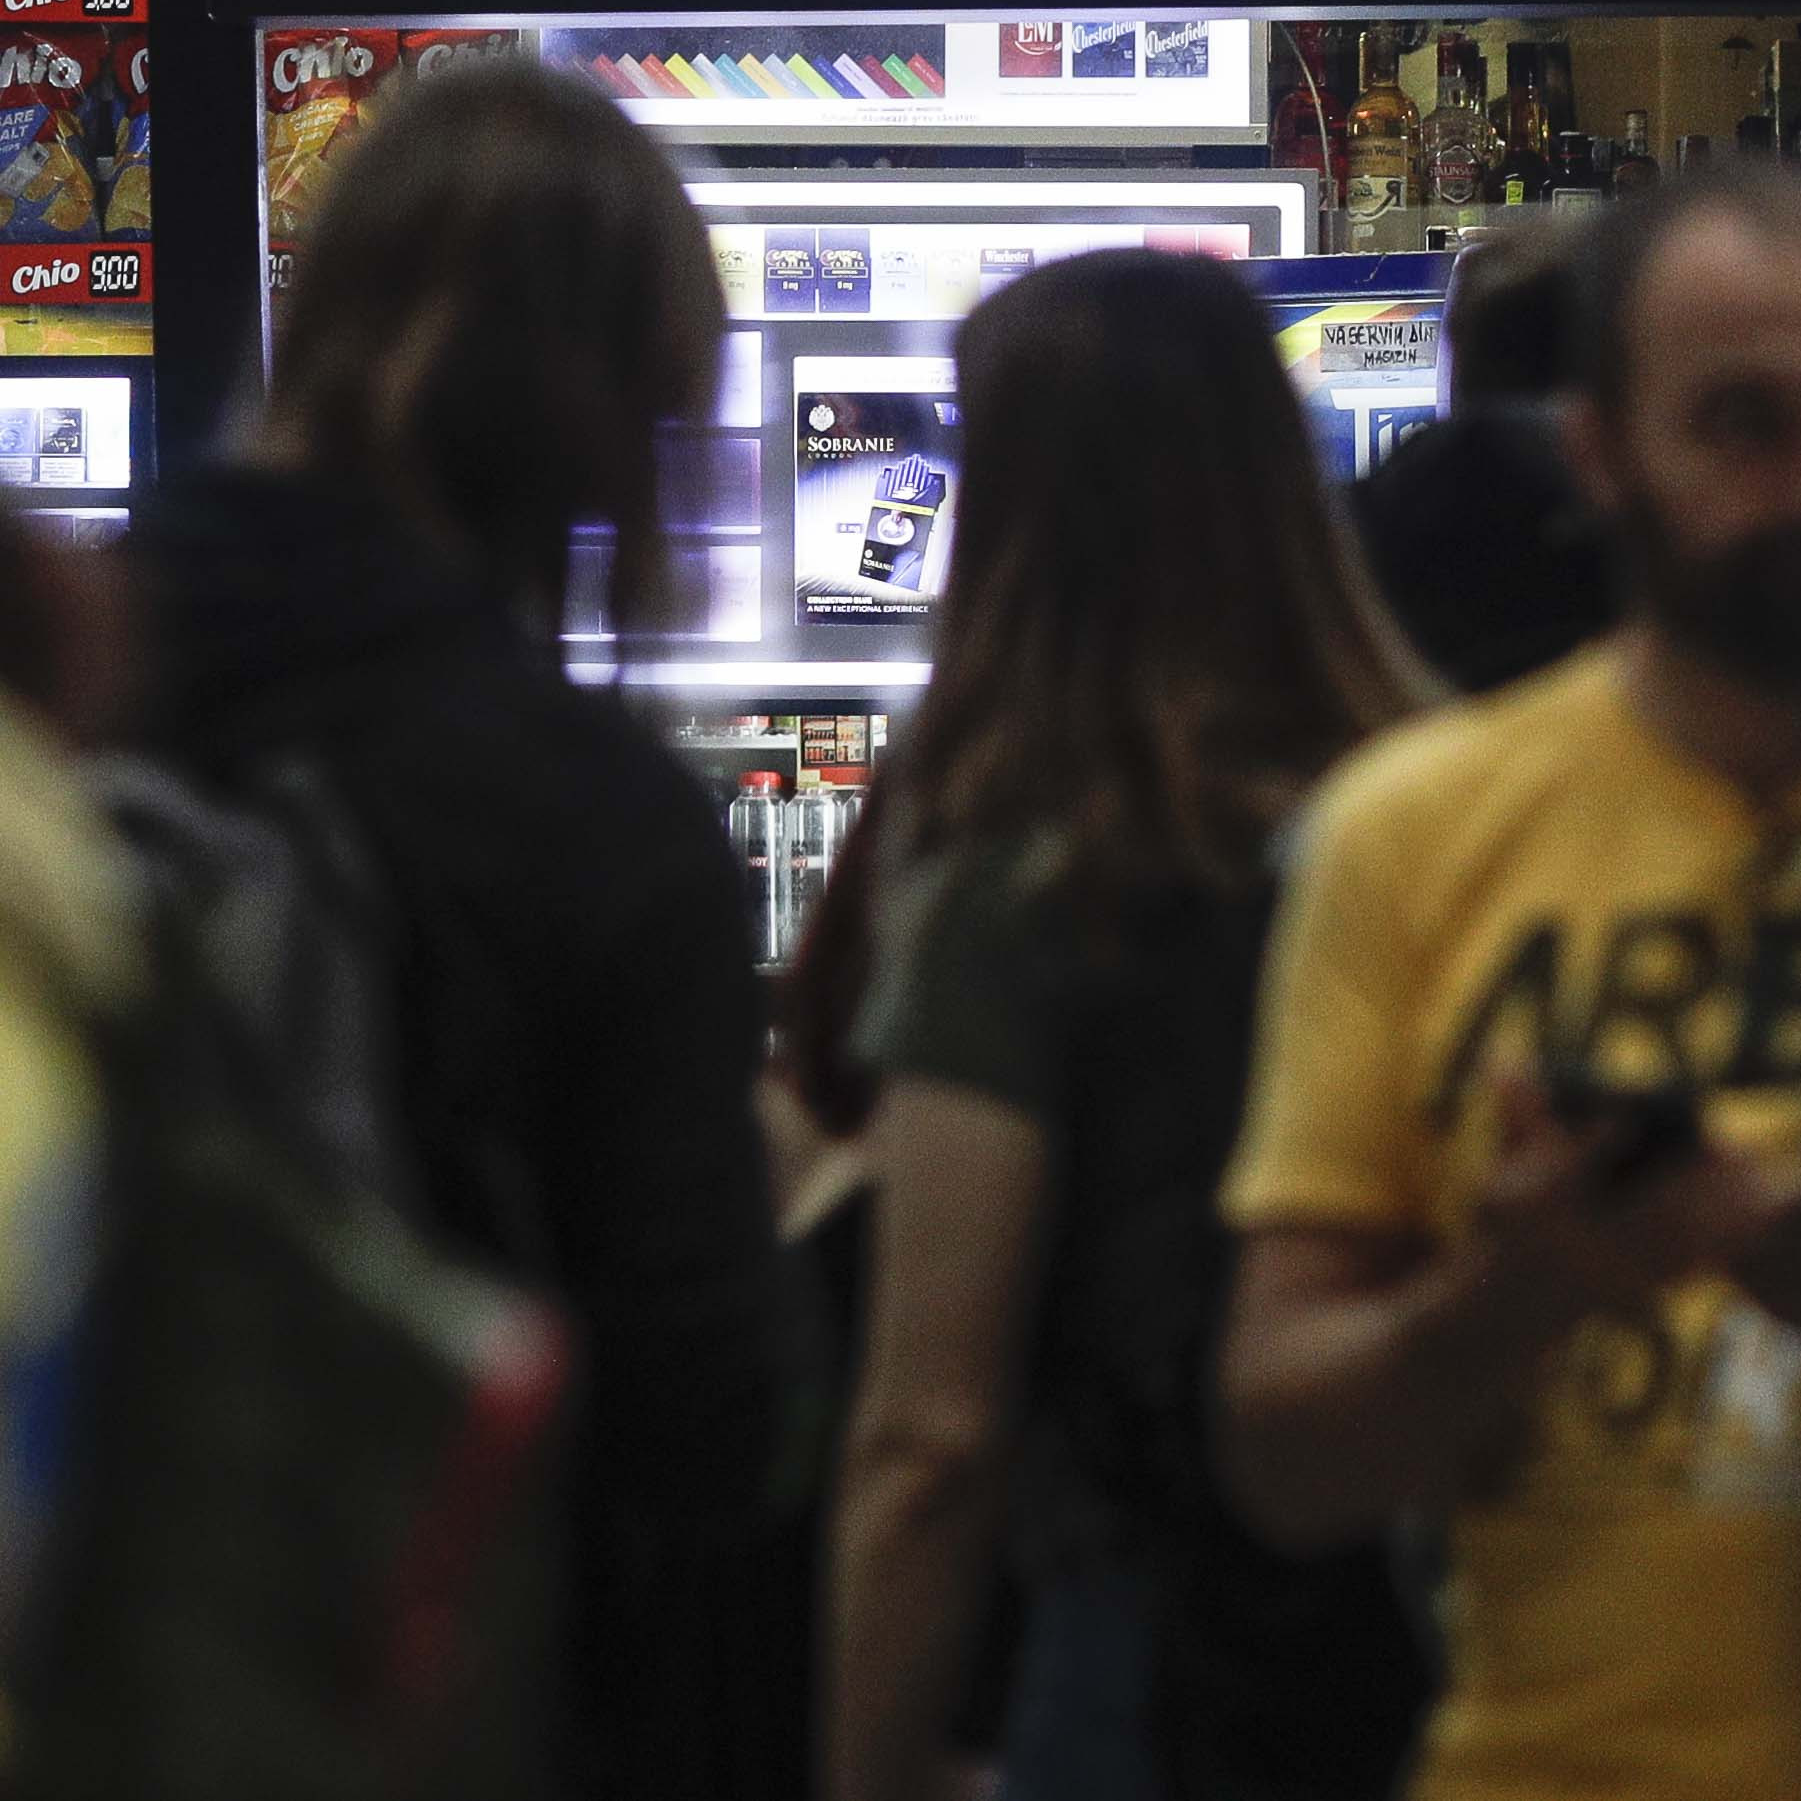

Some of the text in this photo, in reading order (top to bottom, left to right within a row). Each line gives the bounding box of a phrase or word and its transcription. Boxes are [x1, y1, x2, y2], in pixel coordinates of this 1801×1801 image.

[1146, 21, 1209, 58] Chesterfield
[0, 42, 83, 90] hio
[272, 35, 374, 93] Chio
[986, 250, 1030, 265] Winchester
[12, 259, 81, 295] Chio
[807, 436, 895, 453] SOBRANIE
